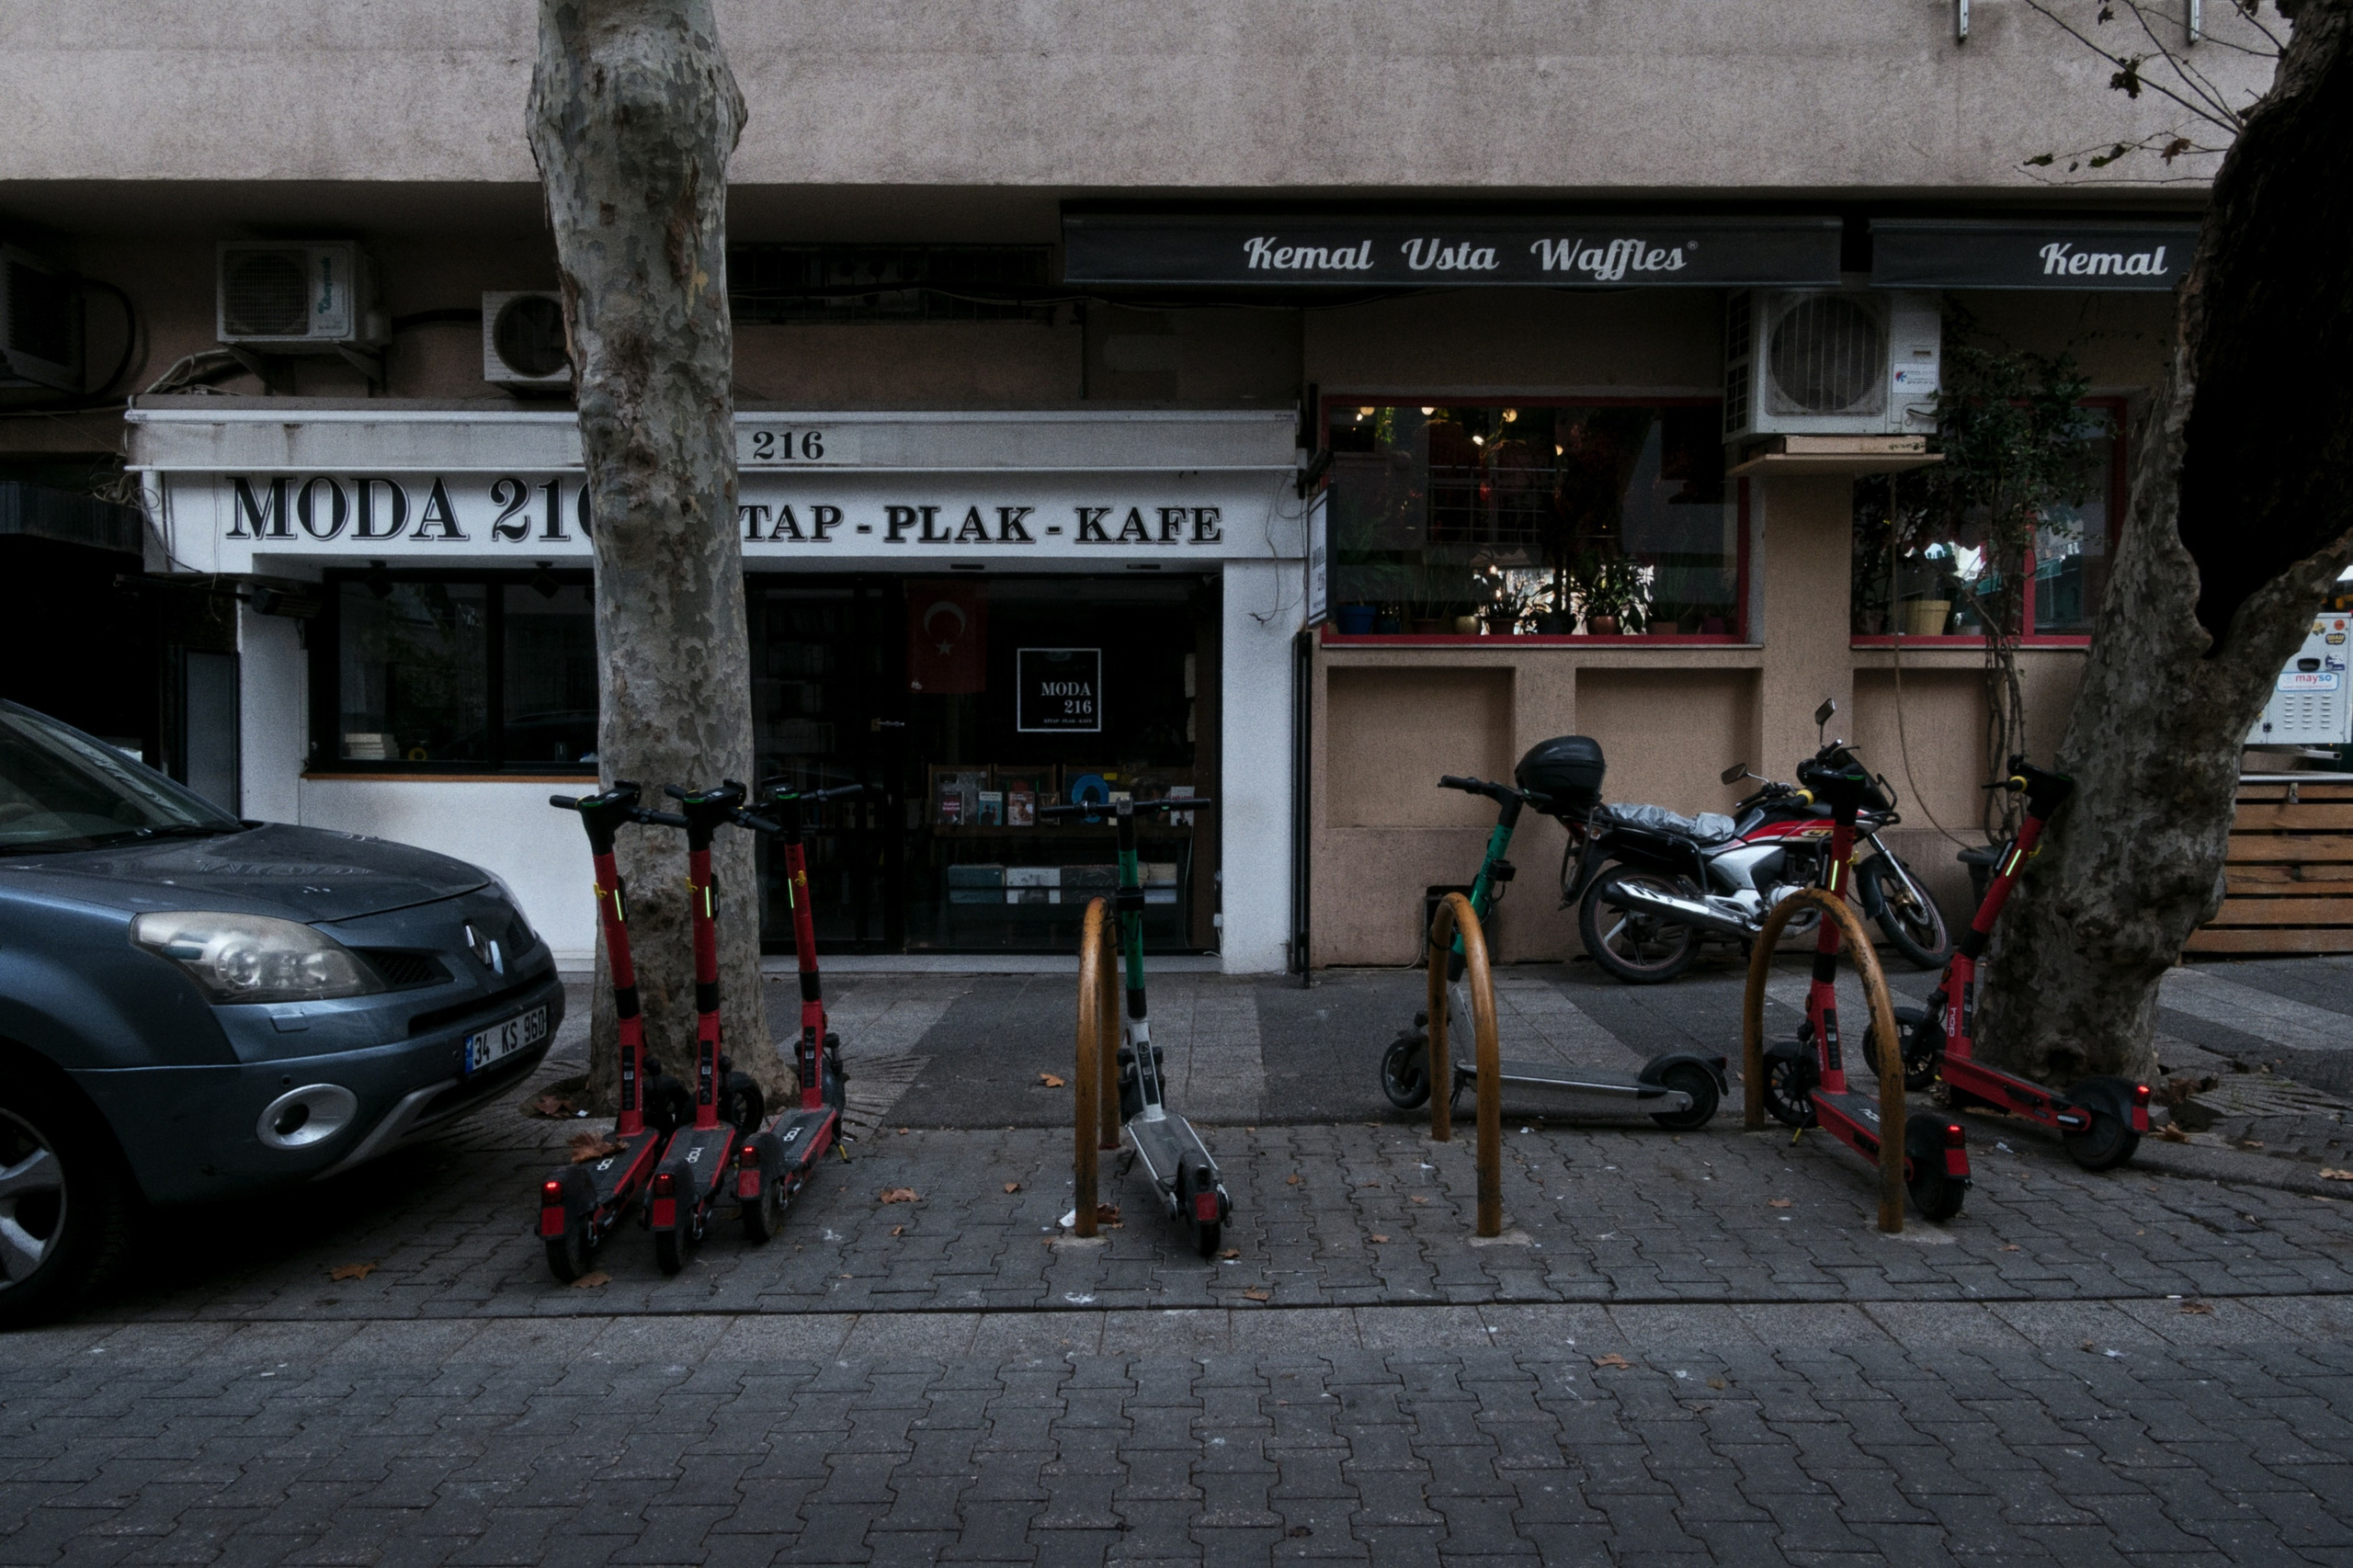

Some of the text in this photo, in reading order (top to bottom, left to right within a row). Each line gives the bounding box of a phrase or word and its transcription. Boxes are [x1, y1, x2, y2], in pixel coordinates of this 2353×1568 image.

[1243, 236, 1374, 270] Kemal
[1401, 238, 1500, 270] Usta
[2039, 243, 2168, 276] Kemal
[753, 431, 824, 460] 216
[226, 476, 470, 540] MODA
[739, 505, 843, 542] TAP
[883, 506, 1036, 543] PLAK
[1074, 506, 1223, 544] KAFE
[1040, 681, 1092, 697] MODA
[2296, 675, 2332, 684] mayso
[1063, 699, 1092, 714] 216
[1949, 1006, 1958, 1038] hop
[474, 1009, 545, 1065] 34 KS 960
[782, 1126, 804, 1142] hop
[596, 1155, 616, 1171] op
[685, 1146, 705, 1164] hop
